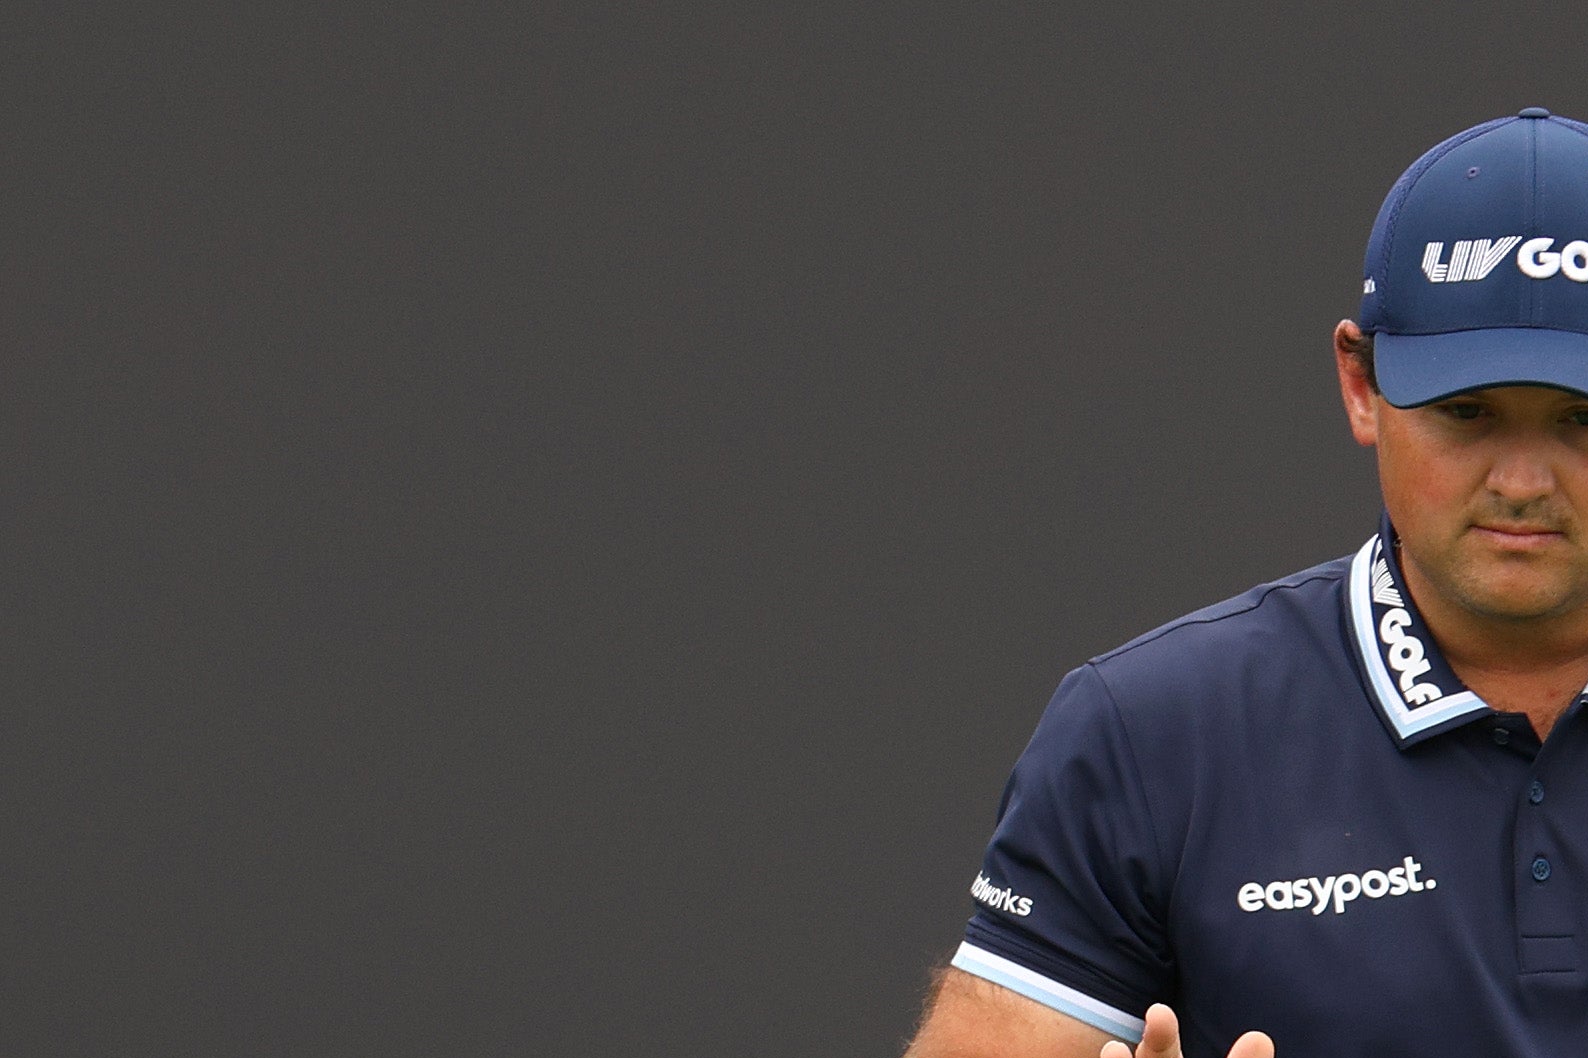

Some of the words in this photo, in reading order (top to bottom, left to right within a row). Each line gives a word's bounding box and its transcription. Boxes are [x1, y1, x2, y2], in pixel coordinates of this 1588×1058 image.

[1421, 236, 1520, 283] LIV
[1379, 608, 1443, 705] GOLF
[1238, 856, 1437, 916] easypost.
